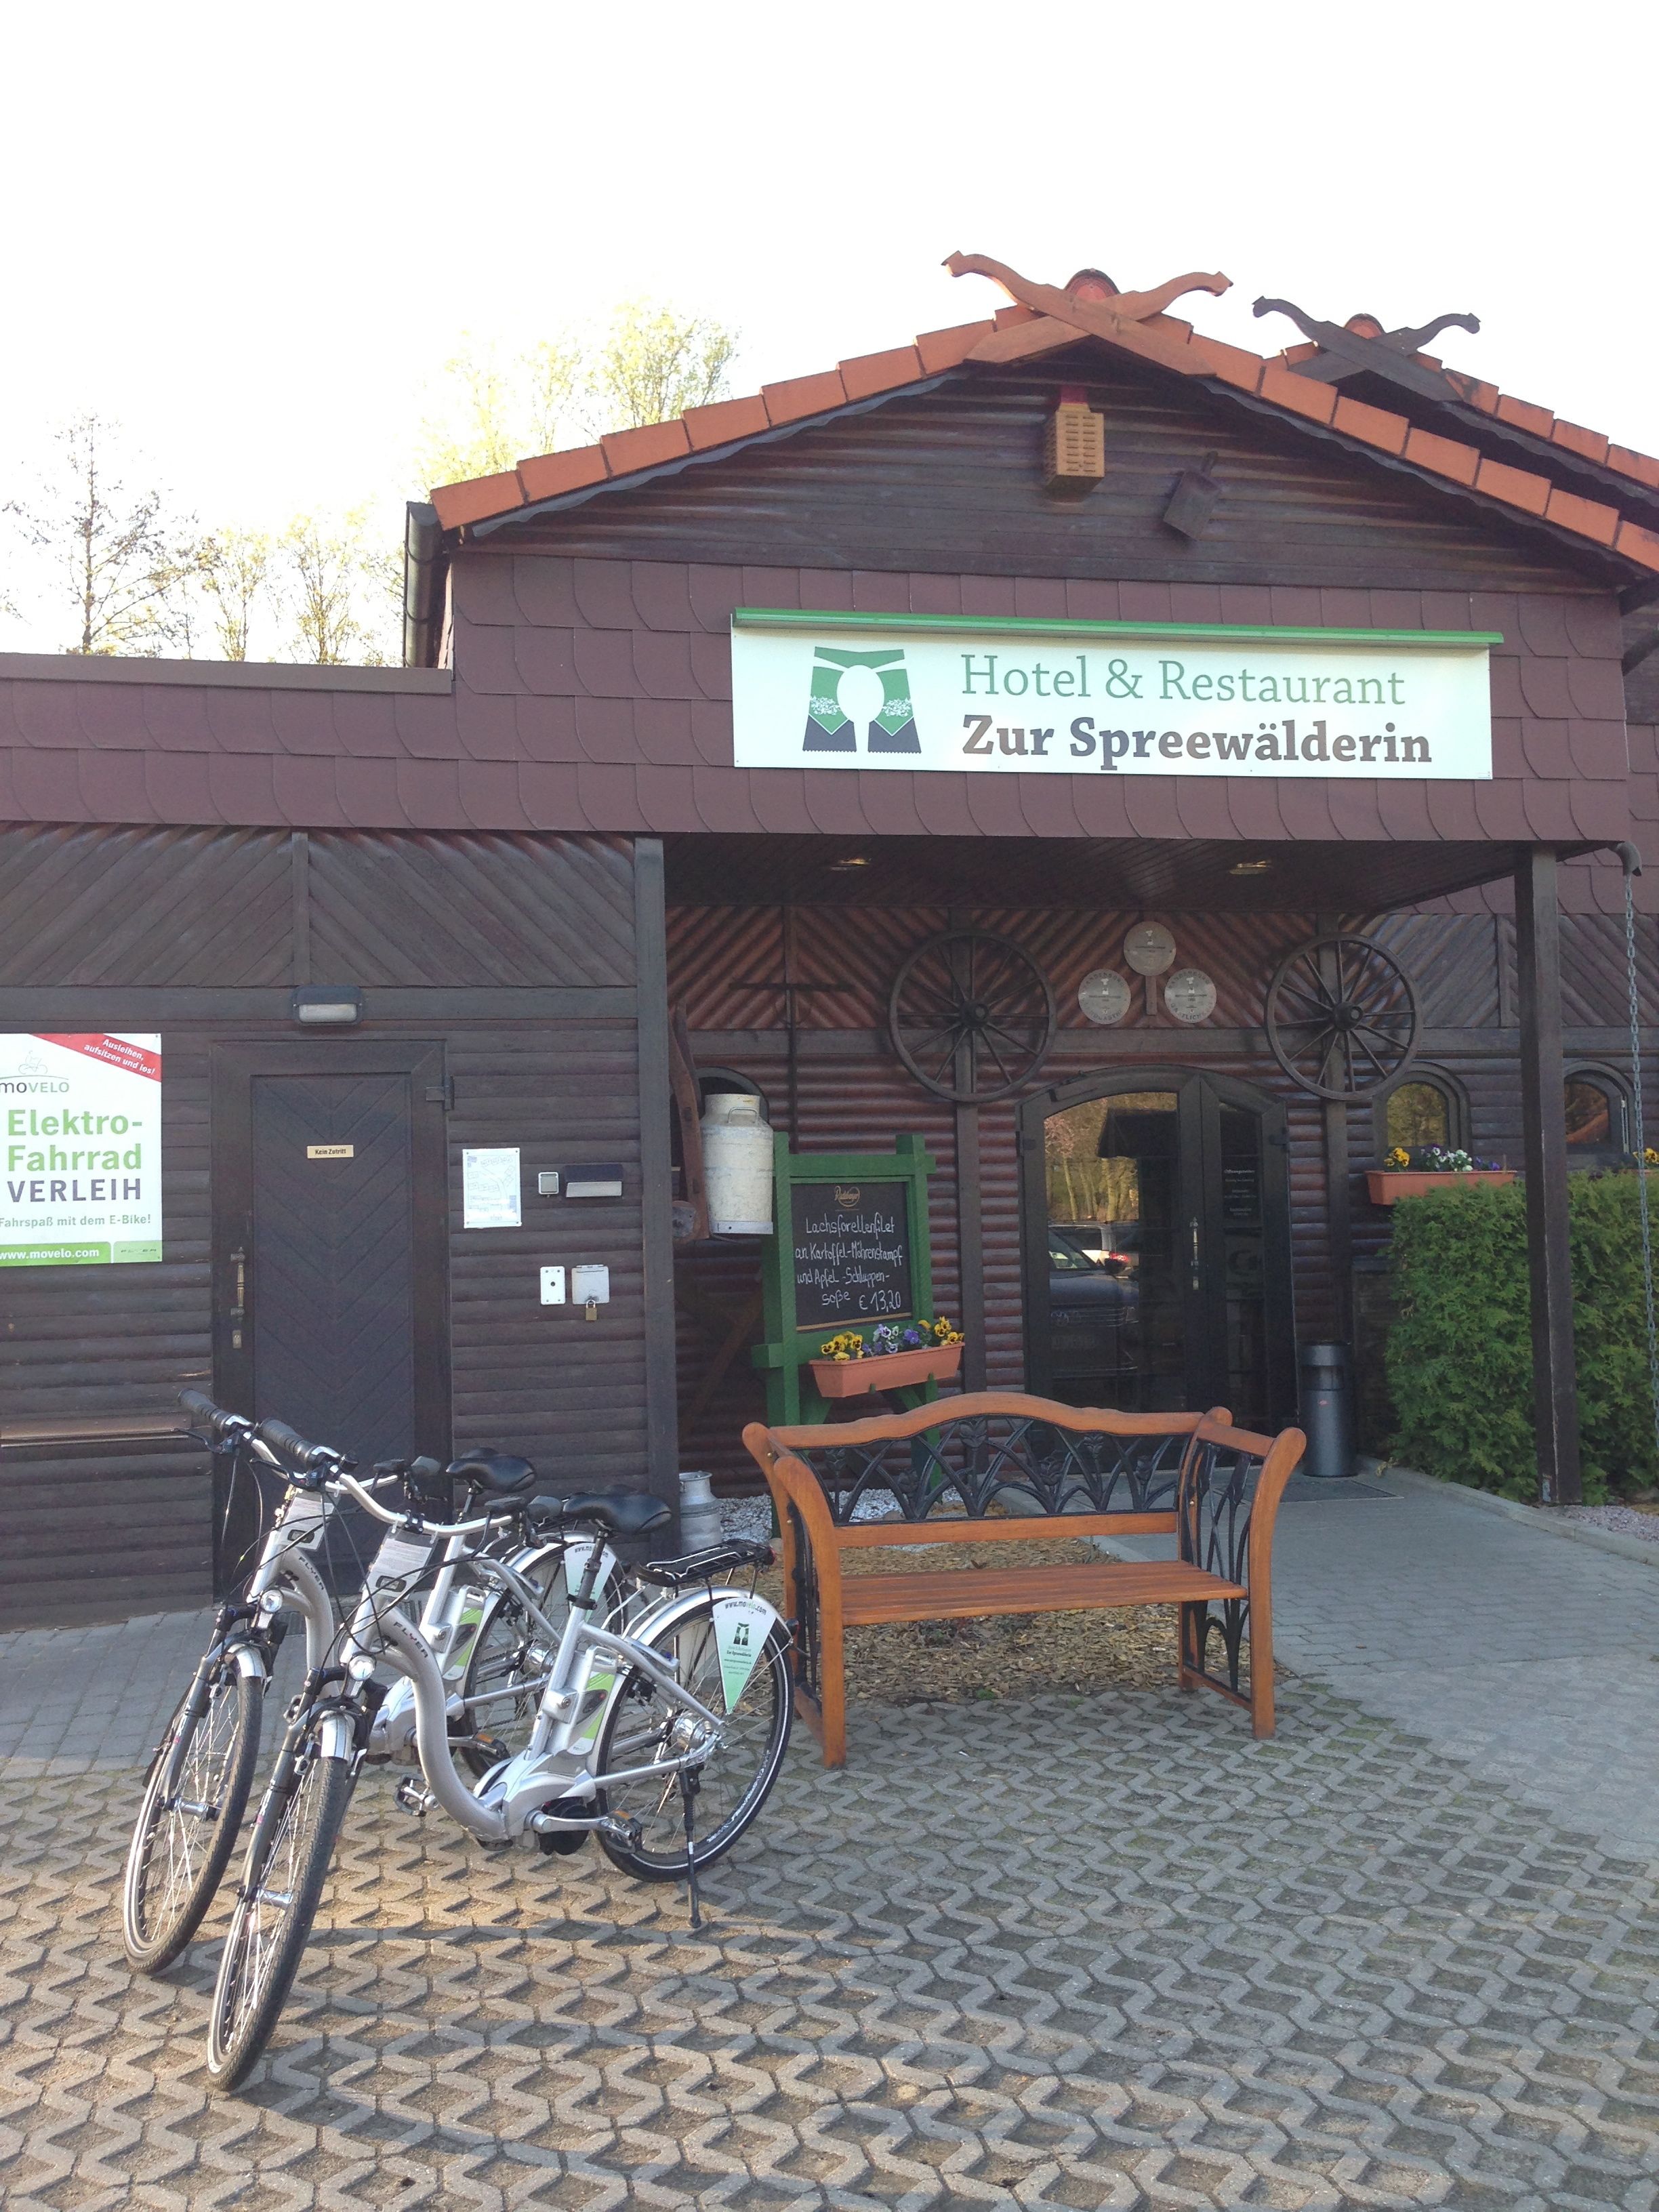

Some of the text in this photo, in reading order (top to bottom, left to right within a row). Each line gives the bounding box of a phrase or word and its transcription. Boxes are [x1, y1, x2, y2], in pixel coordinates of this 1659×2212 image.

[961, 653, 1406, 705] Hotel & Restaurant
[962, 714, 1432, 771] Zur Spreewälderin
[84, 1044, 155, 1075] aufsitzen und los!
[102, 1039, 144, 1061] Ausleihen,
[8, 1109, 142, 1136] Elektro-
[8, 1143, 141, 1172] Fahrrad
[7, 1179, 140, 1202] VERLEIH
[0, 1214, 151, 1229] Fahrspaß mit dem E-Bike!
[806, 1212, 895, 1240] Lachsforellenfilet
[795, 1246, 808, 1259] an
[797, 1268, 813, 1284] und
[815, 1269, 840, 1289] Apfel
[870, 1290, 901, 1313] 13,20
[299, 1556, 324, 1590] FLYER
[393, 1621, 428, 1658] FLYER
